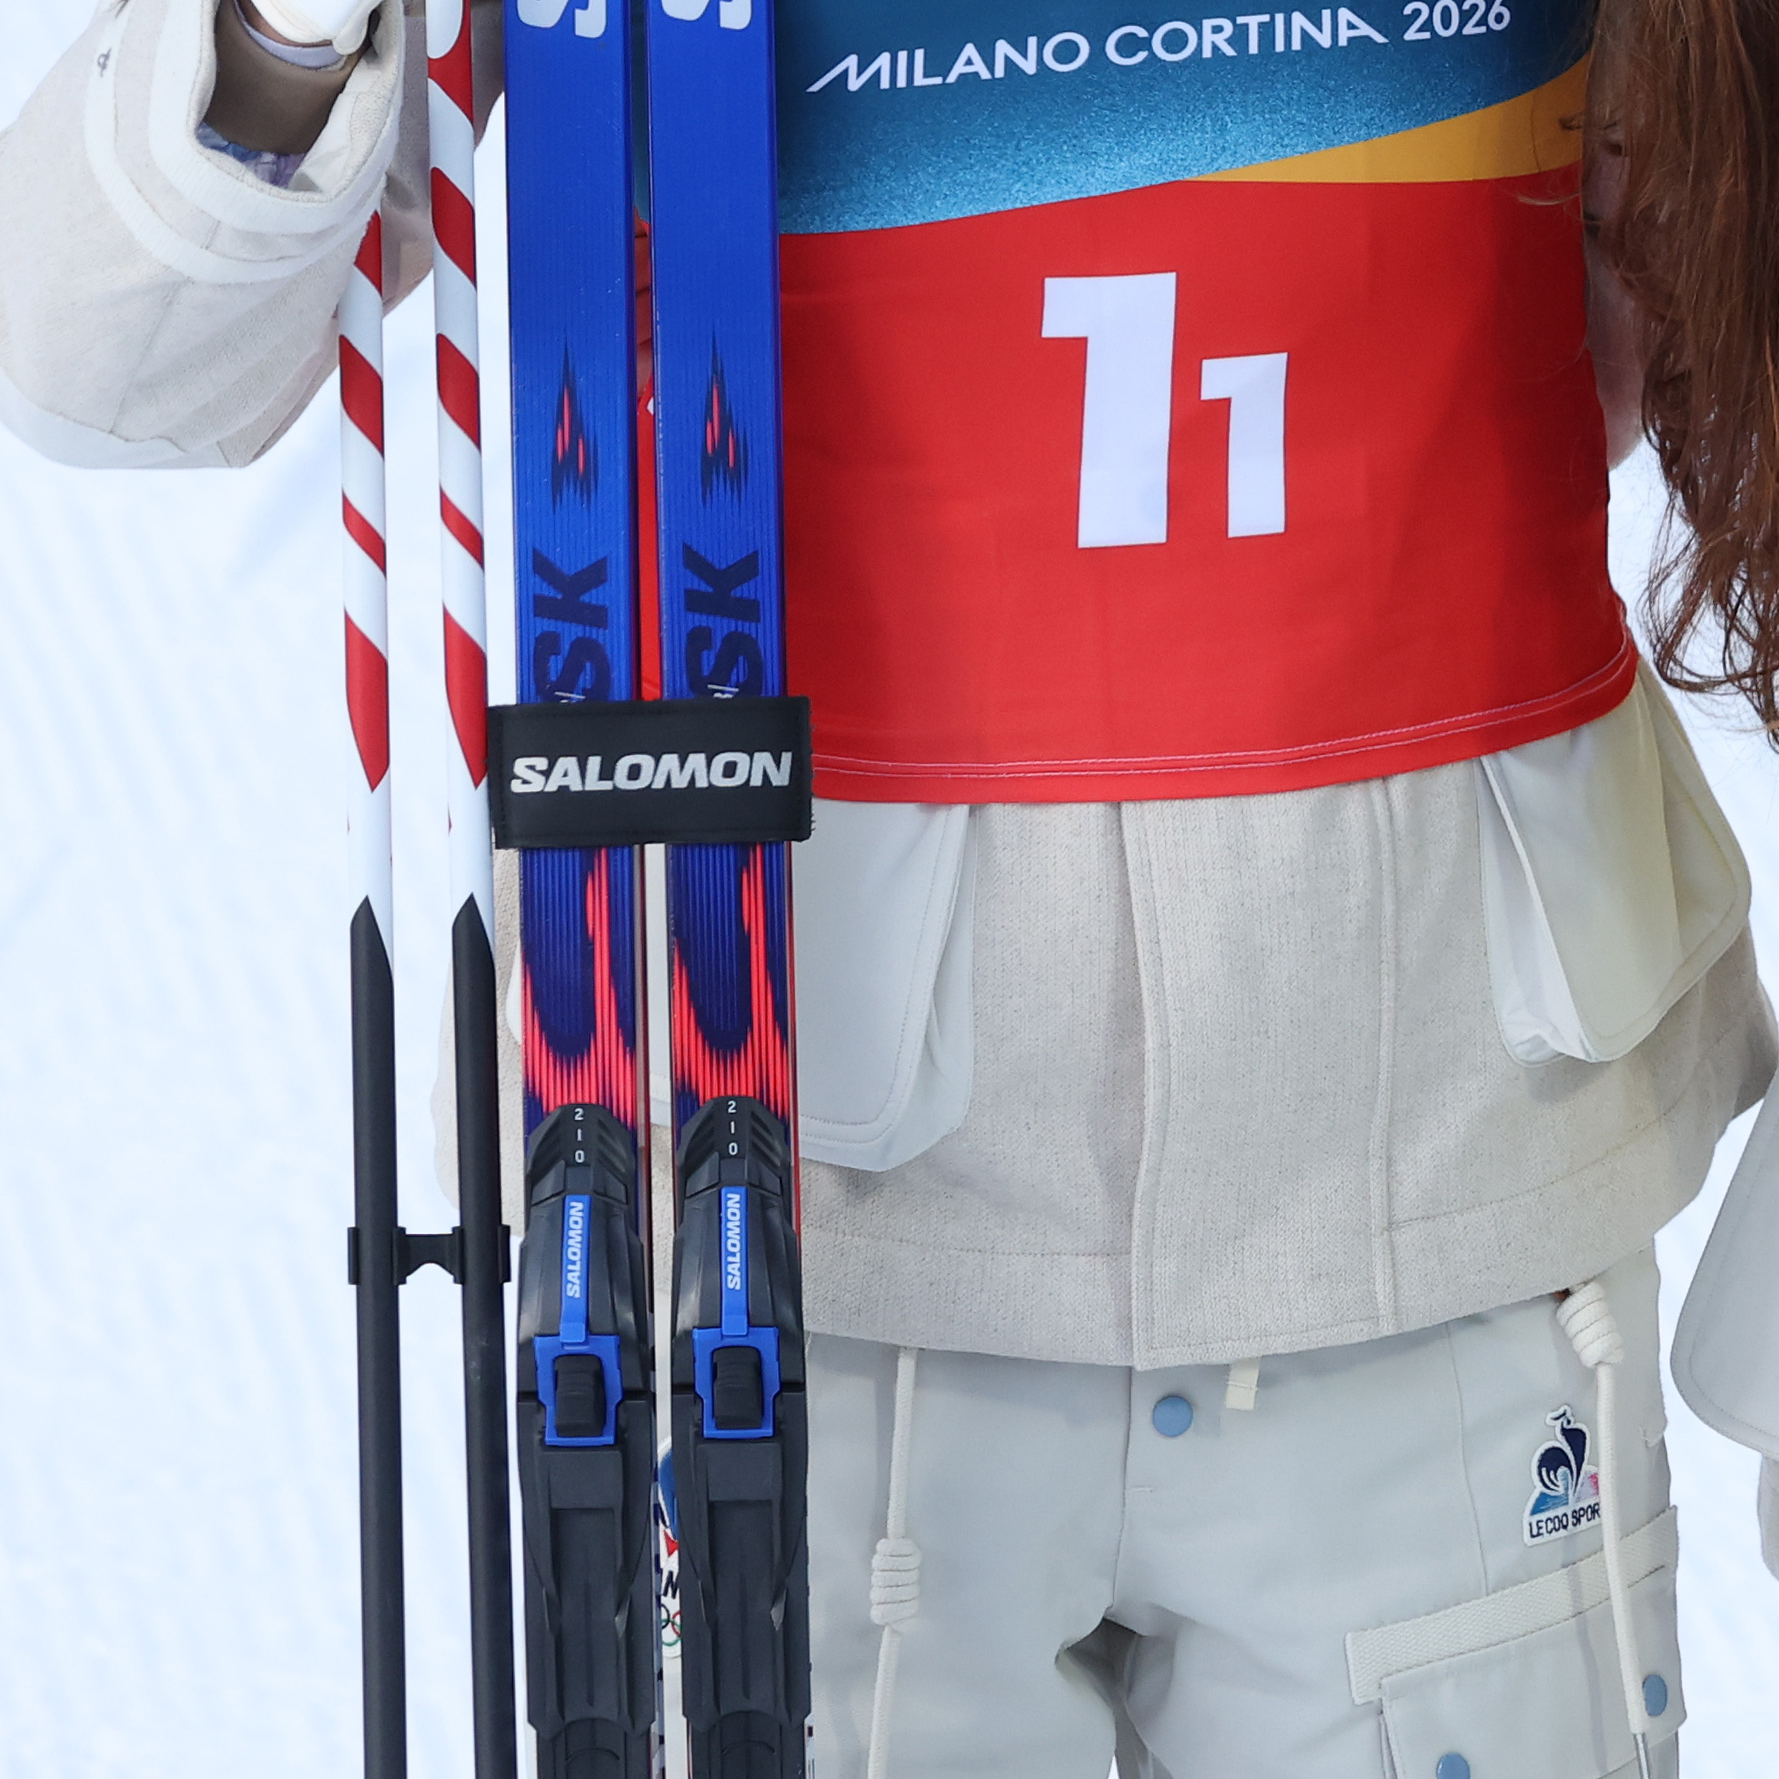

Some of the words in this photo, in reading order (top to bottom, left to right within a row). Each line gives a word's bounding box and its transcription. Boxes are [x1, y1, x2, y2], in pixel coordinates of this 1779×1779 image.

[805, 29, 1090, 94] MILANO
[1105, 4, 1389, 64] CORTINA
[510, 750, 793, 794] SALOMON
[566, 1202, 584, 1298] SALOMON
[727, 1193, 741, 1291] SALOMON
[1530, 1521, 1544, 1539] LE
[1545, 1514, 1570, 1535] COQ
[1571, 1502, 1600, 1528] SPOR
